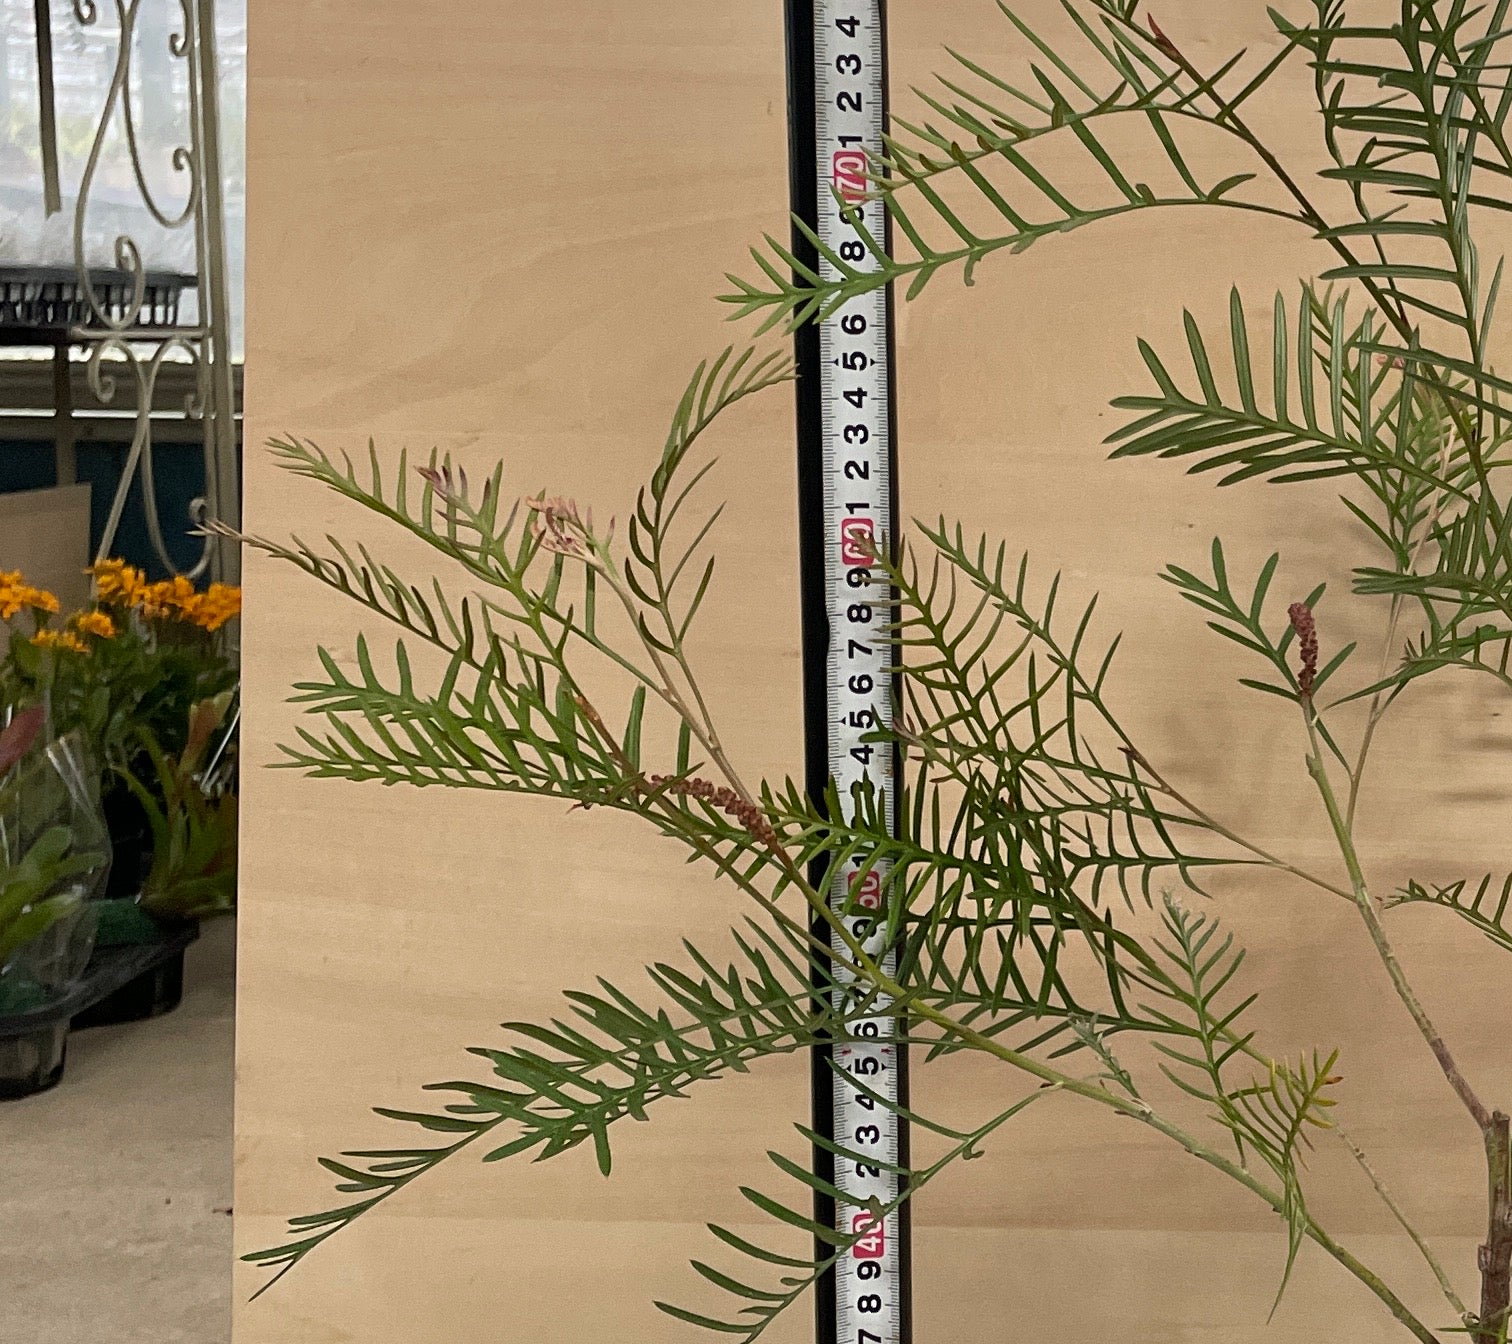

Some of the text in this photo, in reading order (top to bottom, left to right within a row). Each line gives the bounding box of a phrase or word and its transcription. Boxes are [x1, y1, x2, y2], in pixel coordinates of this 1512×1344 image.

[835, 15, 861, 38] 4
[835, 53, 862, 76] 3
[836, 91, 863, 113] 2
[837, 135, 863, 149] 1
[839, 240, 866, 262] 8
[841, 314, 867, 335] 6
[842, 351, 868, 371] 5
[842, 387, 868, 409] 4
[843, 423, 869, 445] 3
[843, 460, 870, 480] 2
[845, 502, 870, 515] 1
[846, 567, 872, 589] 9
[846, 603, 873, 624] 8
[847, 639, 873, 659] 7
[848, 674, 874, 695] 6
[848, 709, 874, 730] 5
[849, 744, 875, 765] 4
[853, 1021, 879, 1041] 6
[854, 1056, 879, 1076] 5
[855, 1124, 880, 1145] 3
[856, 1260, 882, 1281] 9
[857, 1293, 882, 1314] 8
